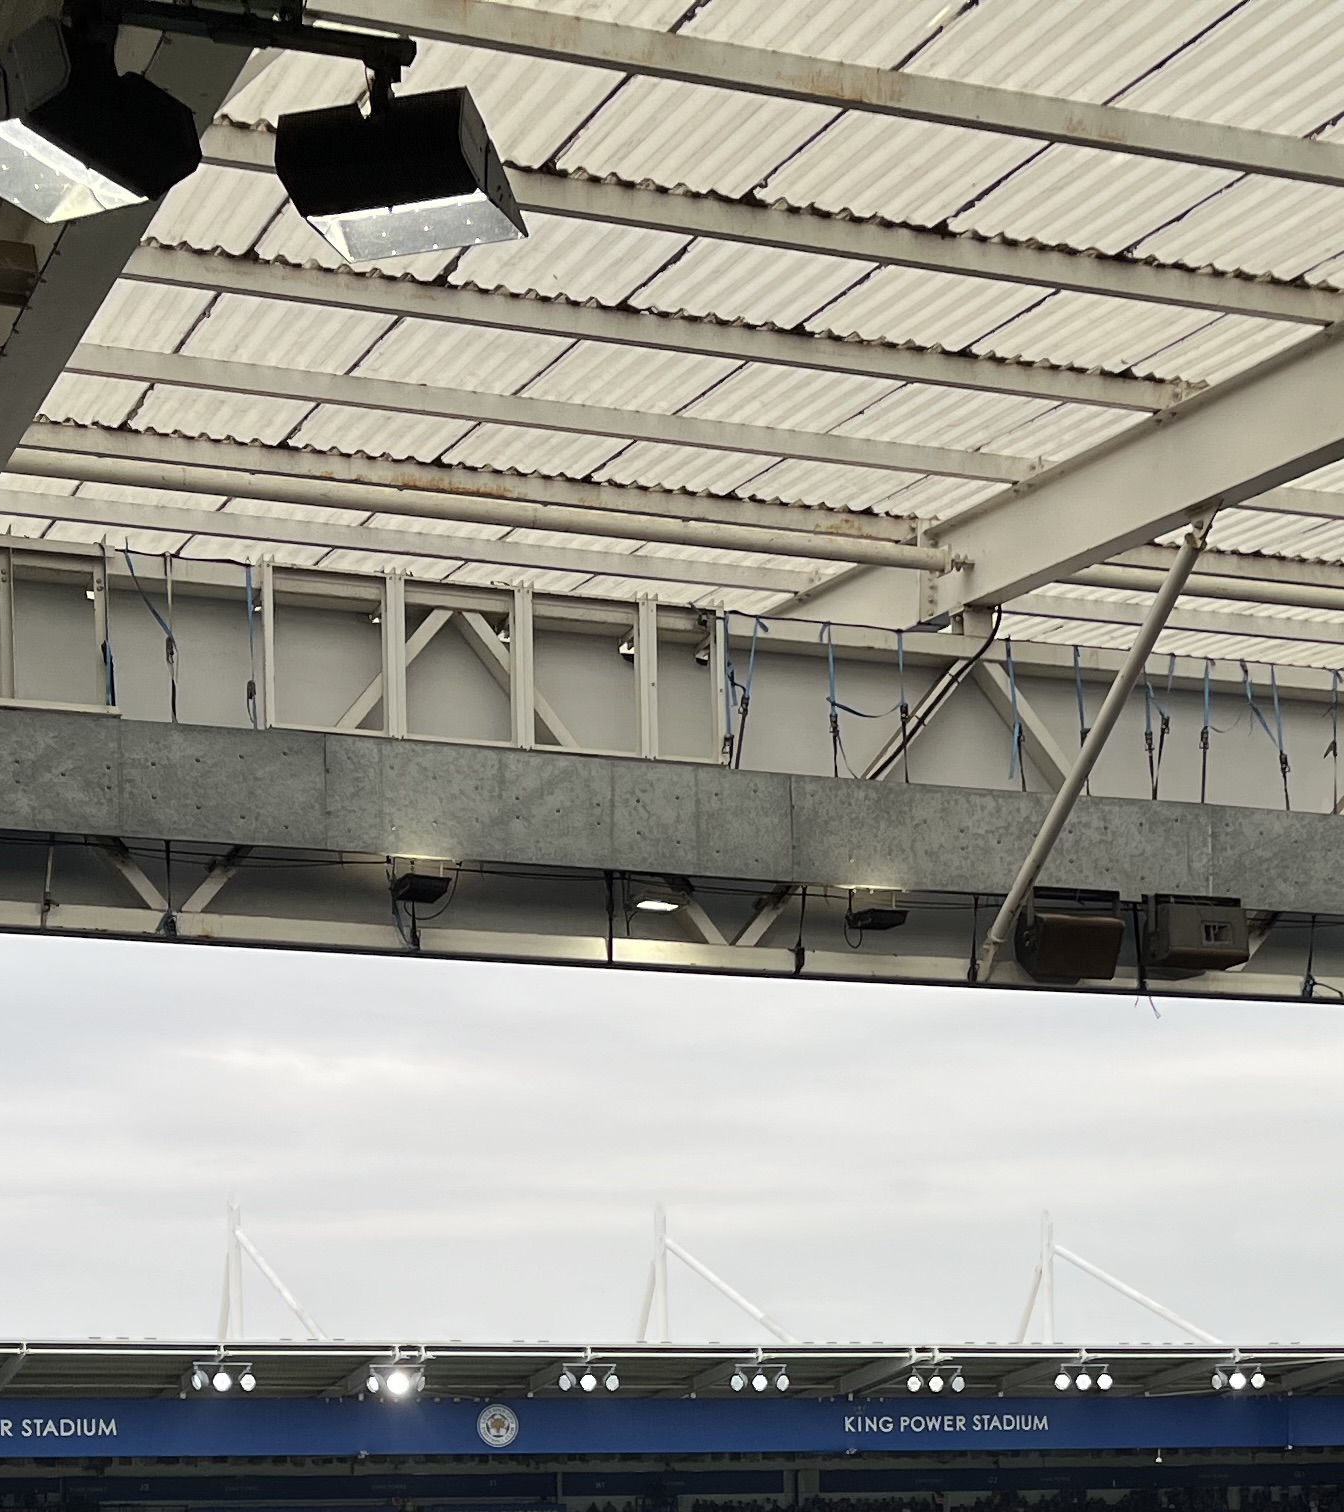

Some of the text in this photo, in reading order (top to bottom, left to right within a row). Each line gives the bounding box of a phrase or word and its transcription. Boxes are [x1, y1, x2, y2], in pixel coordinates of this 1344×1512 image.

[21, 1418, 118, 1437] STADIUM
[844, 1415, 1048, 1432] KING POWER STADIUM
